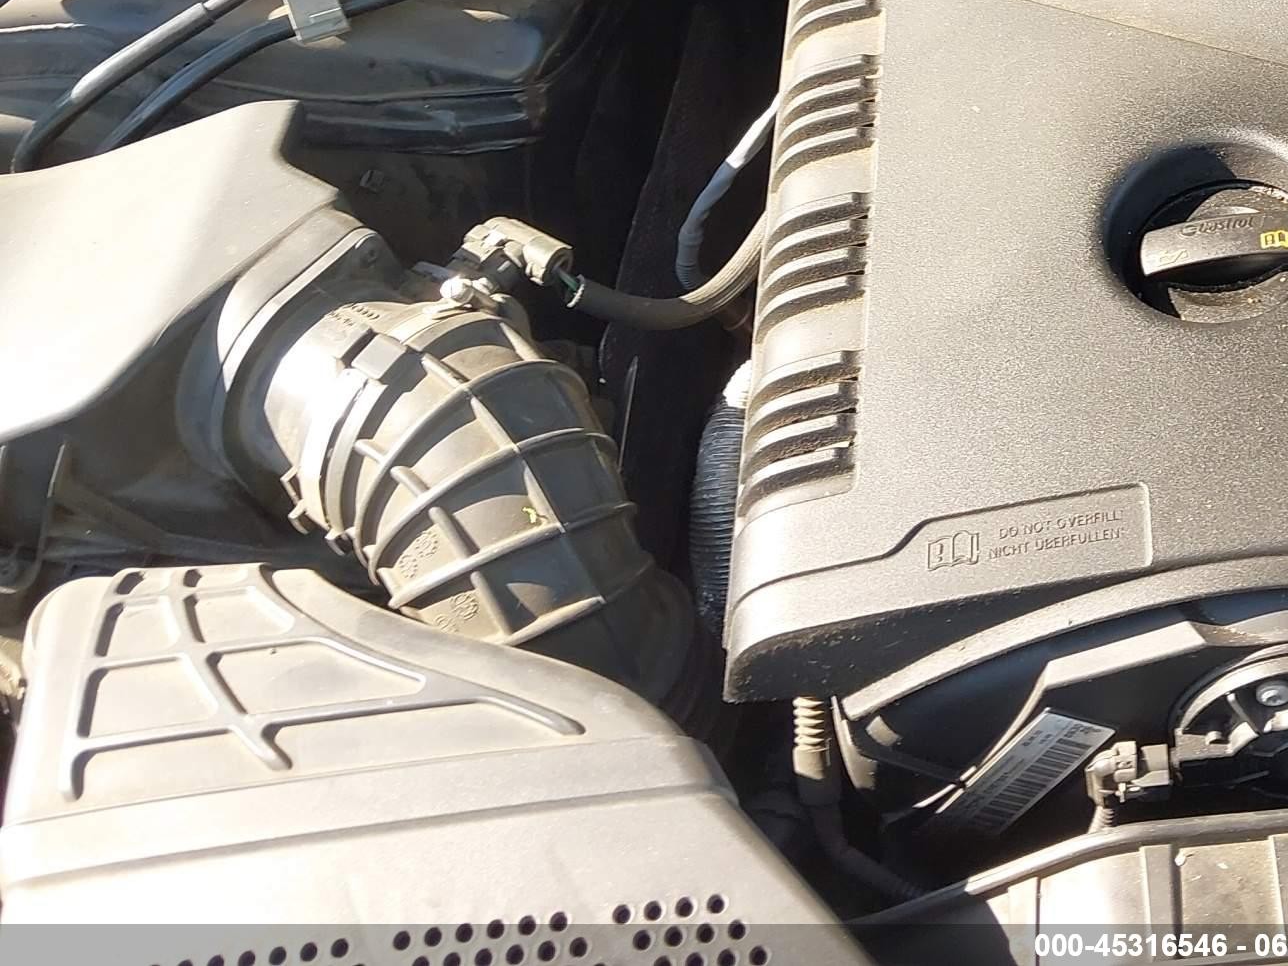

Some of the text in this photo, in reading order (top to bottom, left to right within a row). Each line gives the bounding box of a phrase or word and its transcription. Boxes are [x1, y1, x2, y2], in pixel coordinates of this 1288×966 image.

[999, 527, 1018, 539] DO
[1024, 520, 1052, 535] NOT
[989, 542, 1029, 558] NICHT
